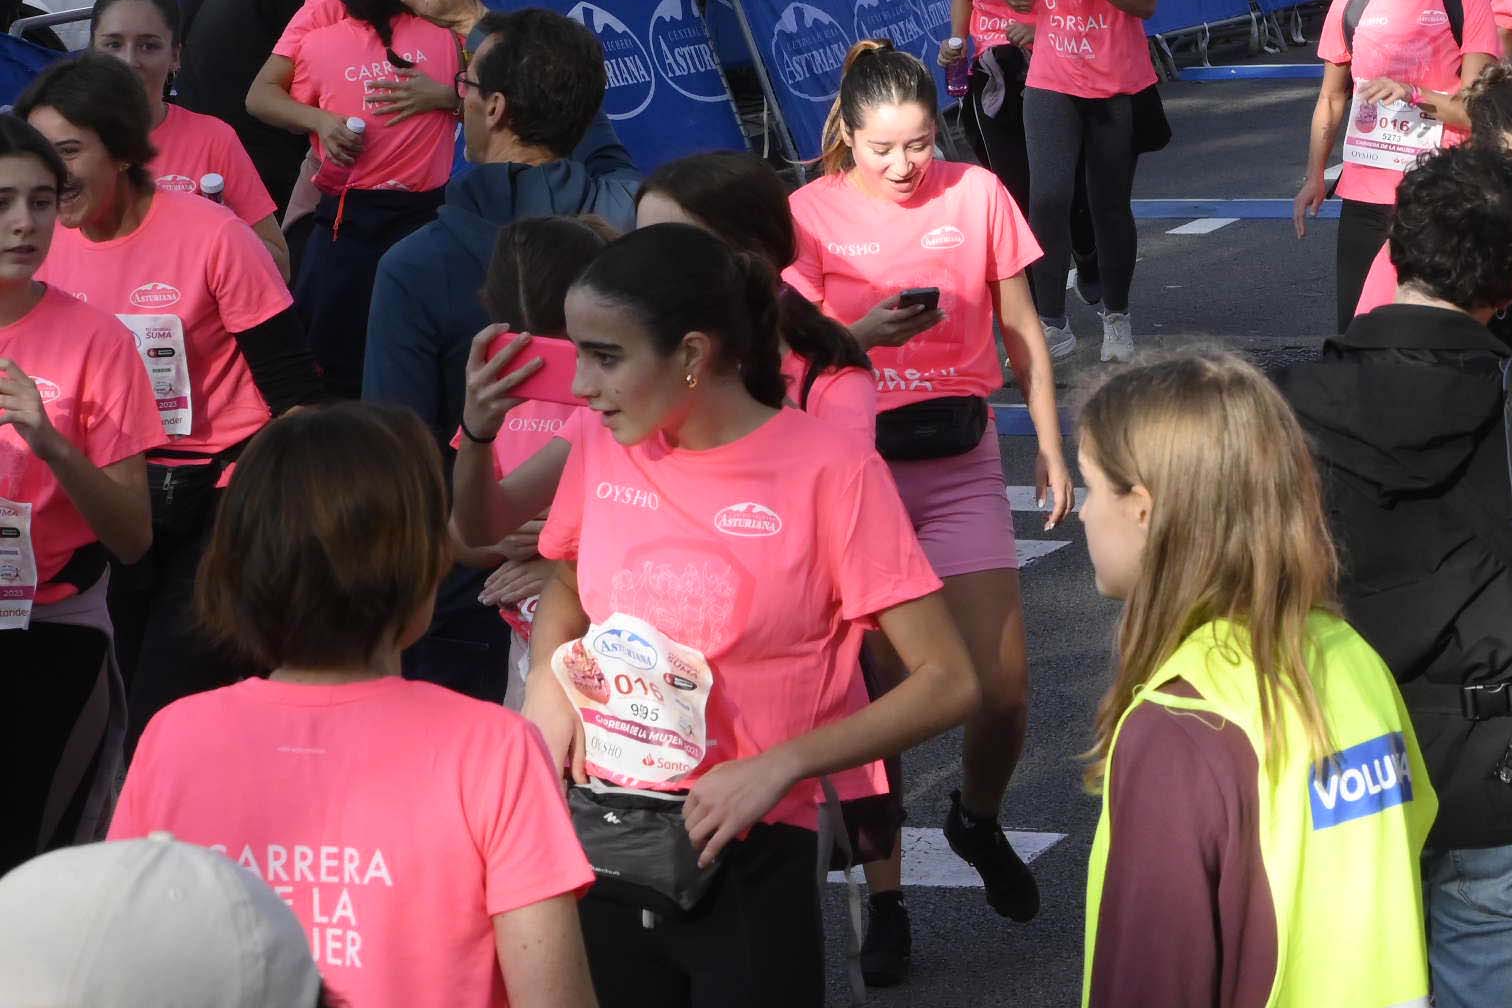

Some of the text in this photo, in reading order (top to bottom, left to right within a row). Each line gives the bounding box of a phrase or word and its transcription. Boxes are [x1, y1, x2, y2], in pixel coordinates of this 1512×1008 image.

[1379, 116, 1410, 132] 016
[827, 242, 880, 257] OYSHO
[134, 293, 177, 303] ASTURIANA
[146, 332, 173, 340] SUMA
[595, 481, 660, 511] OYSHO
[718, 514, 778, 533] ASTURIANA
[313, 887, 358, 924] LA
